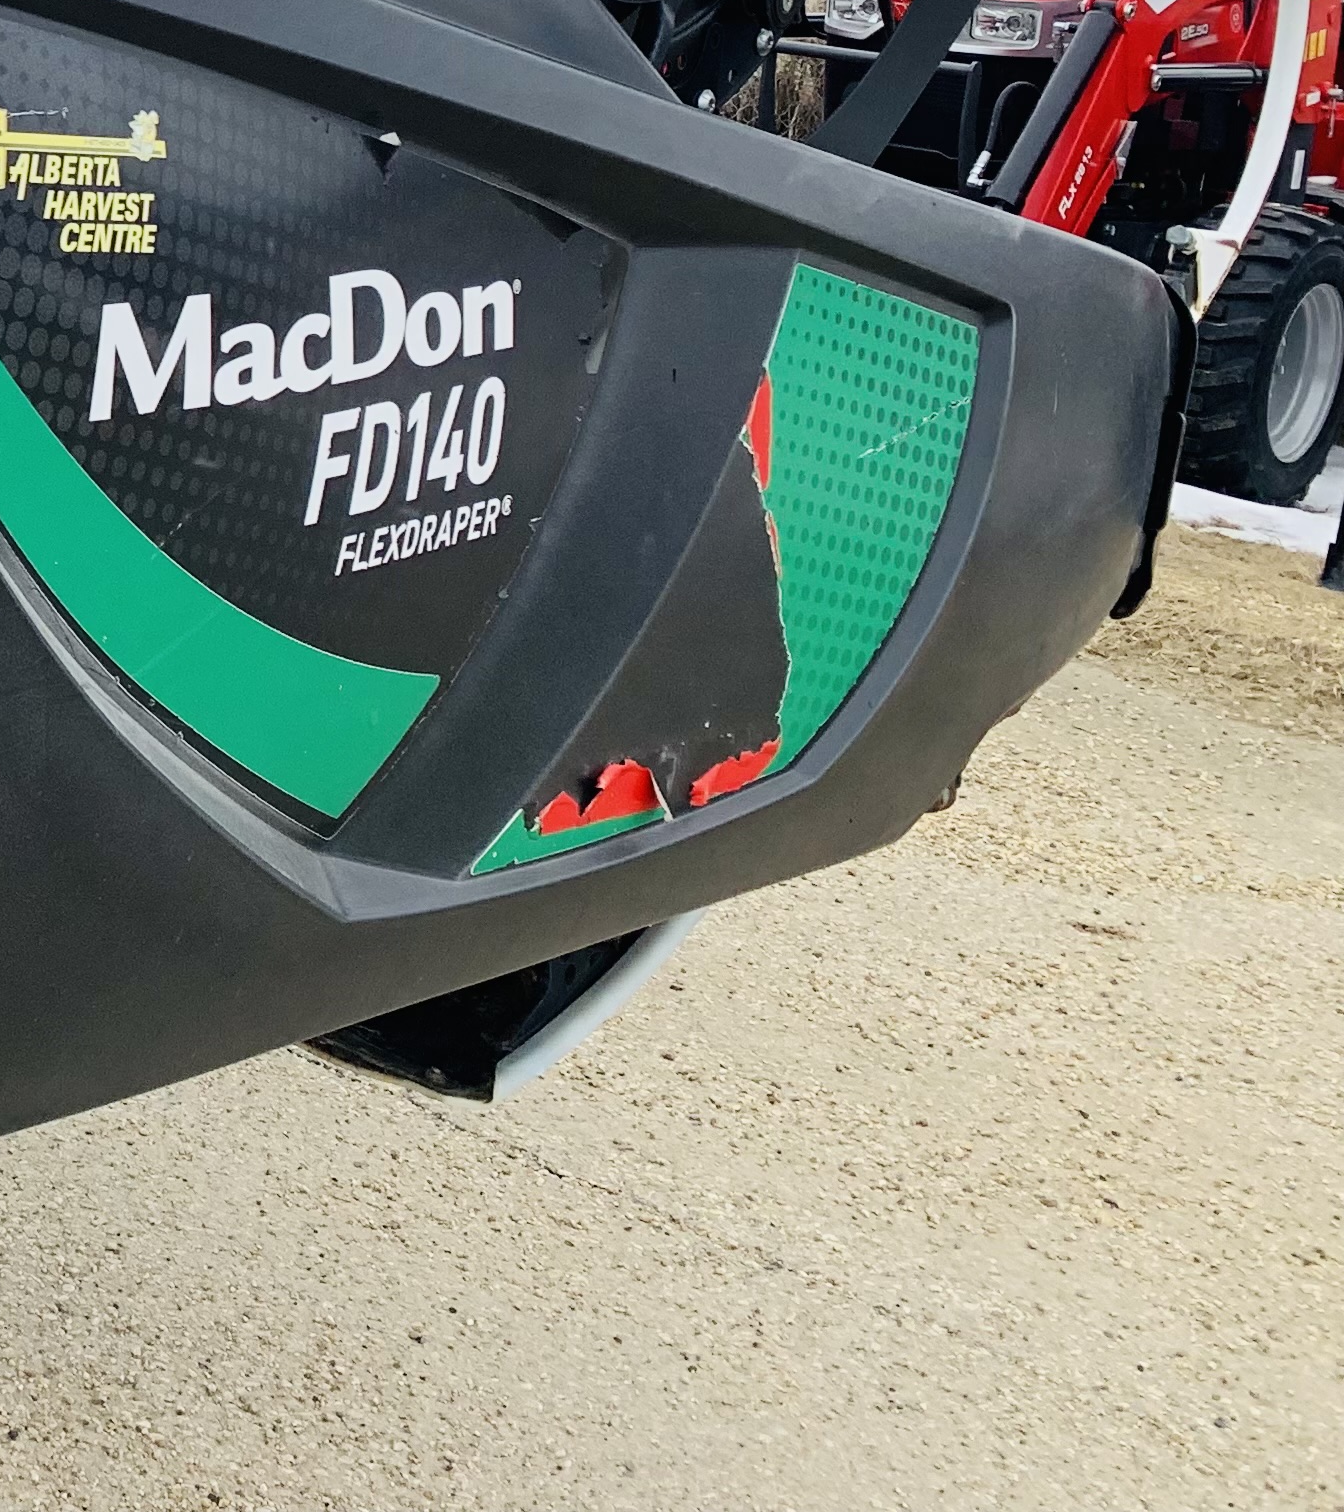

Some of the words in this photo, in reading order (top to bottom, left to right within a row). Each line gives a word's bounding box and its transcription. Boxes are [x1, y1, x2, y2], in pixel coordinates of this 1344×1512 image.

[9, 153, 122, 201] ALBERTA
[43, 190, 155, 222] HARVEST
[59, 223, 157, 254] CENTRE
[88, 268, 514, 422] MacDon
[303, 375, 506, 527] FD140
[334, 500, 501, 577] FLEXDRAPER
